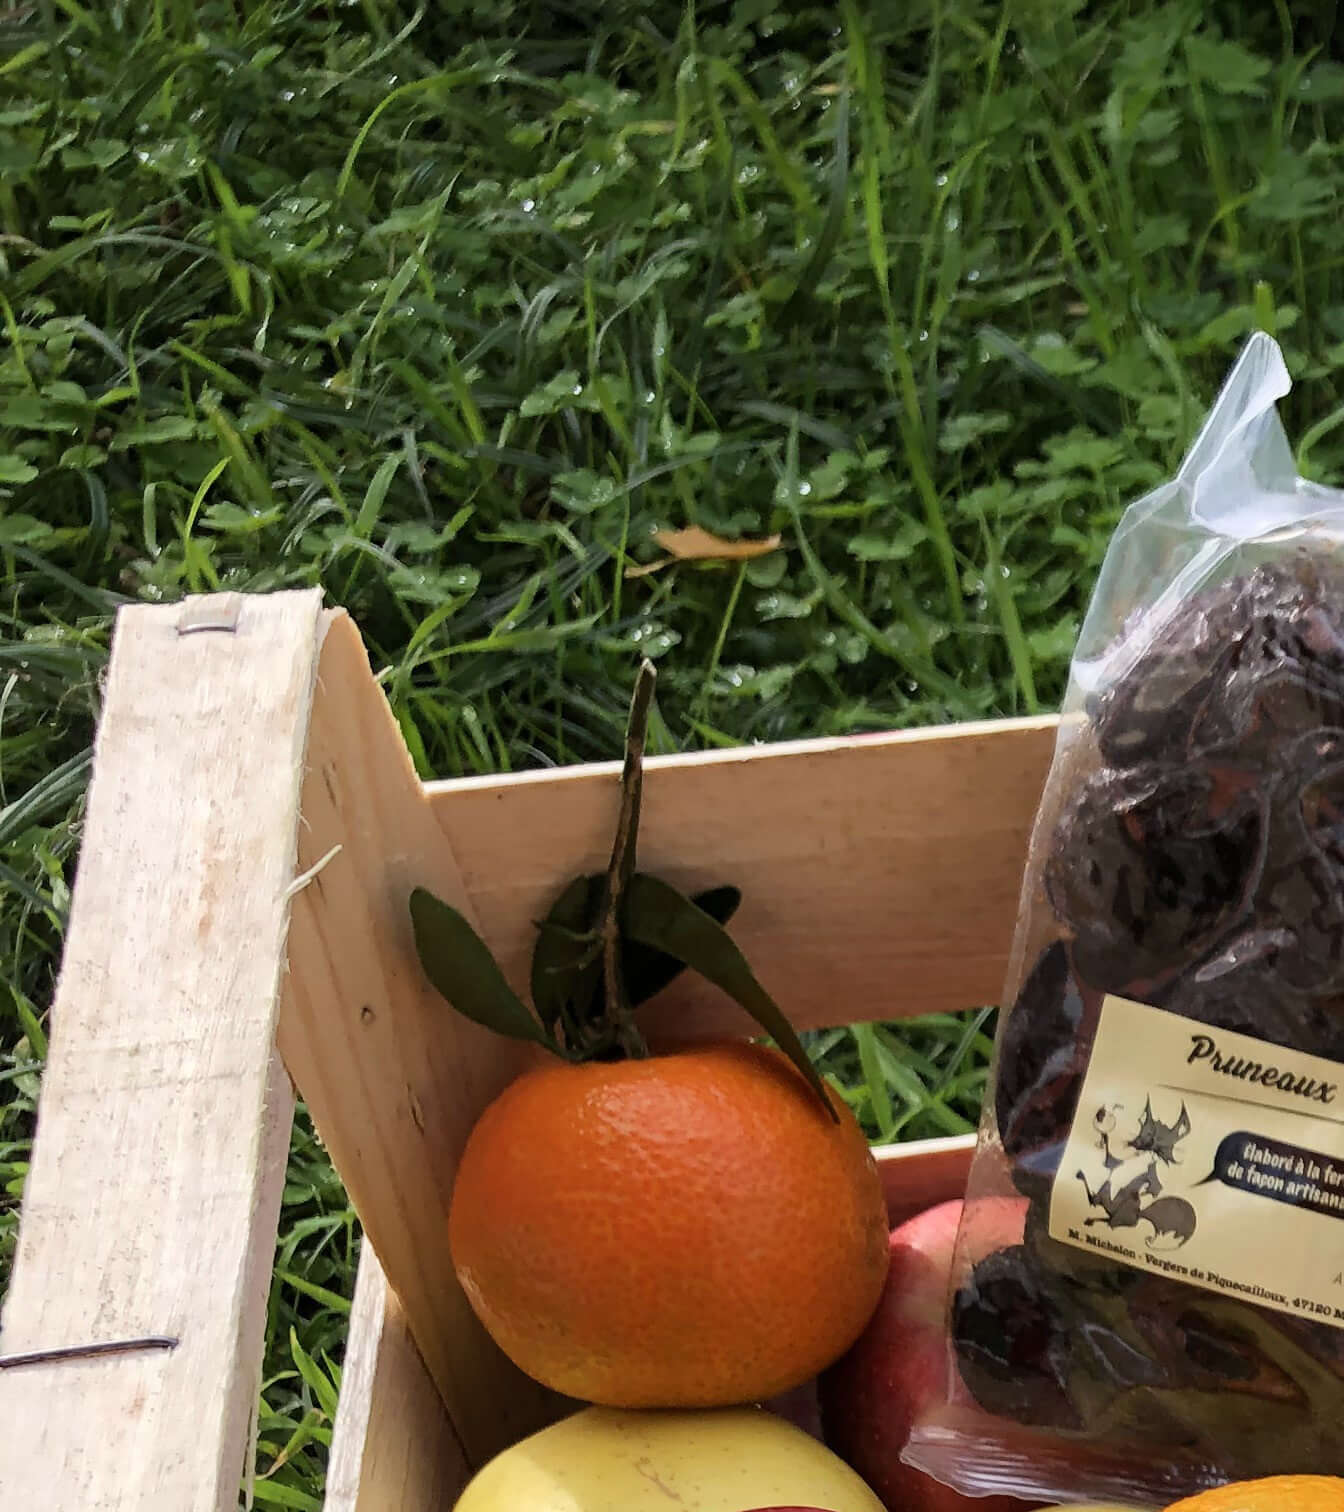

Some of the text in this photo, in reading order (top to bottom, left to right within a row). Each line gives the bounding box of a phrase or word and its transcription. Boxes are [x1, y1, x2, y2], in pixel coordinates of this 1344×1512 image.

[1186, 1034, 1338, 1104] Pruneaux
[1227, 1161, 1244, 1180] de
[1247, 1164, 1285, 1191] façon
[1295, 1157, 1305, 1176] à
[1307, 1161, 1321, 1179] la
[1144, 1252, 1188, 1274] Vergers
[1190, 1267, 1205, 1280] de
